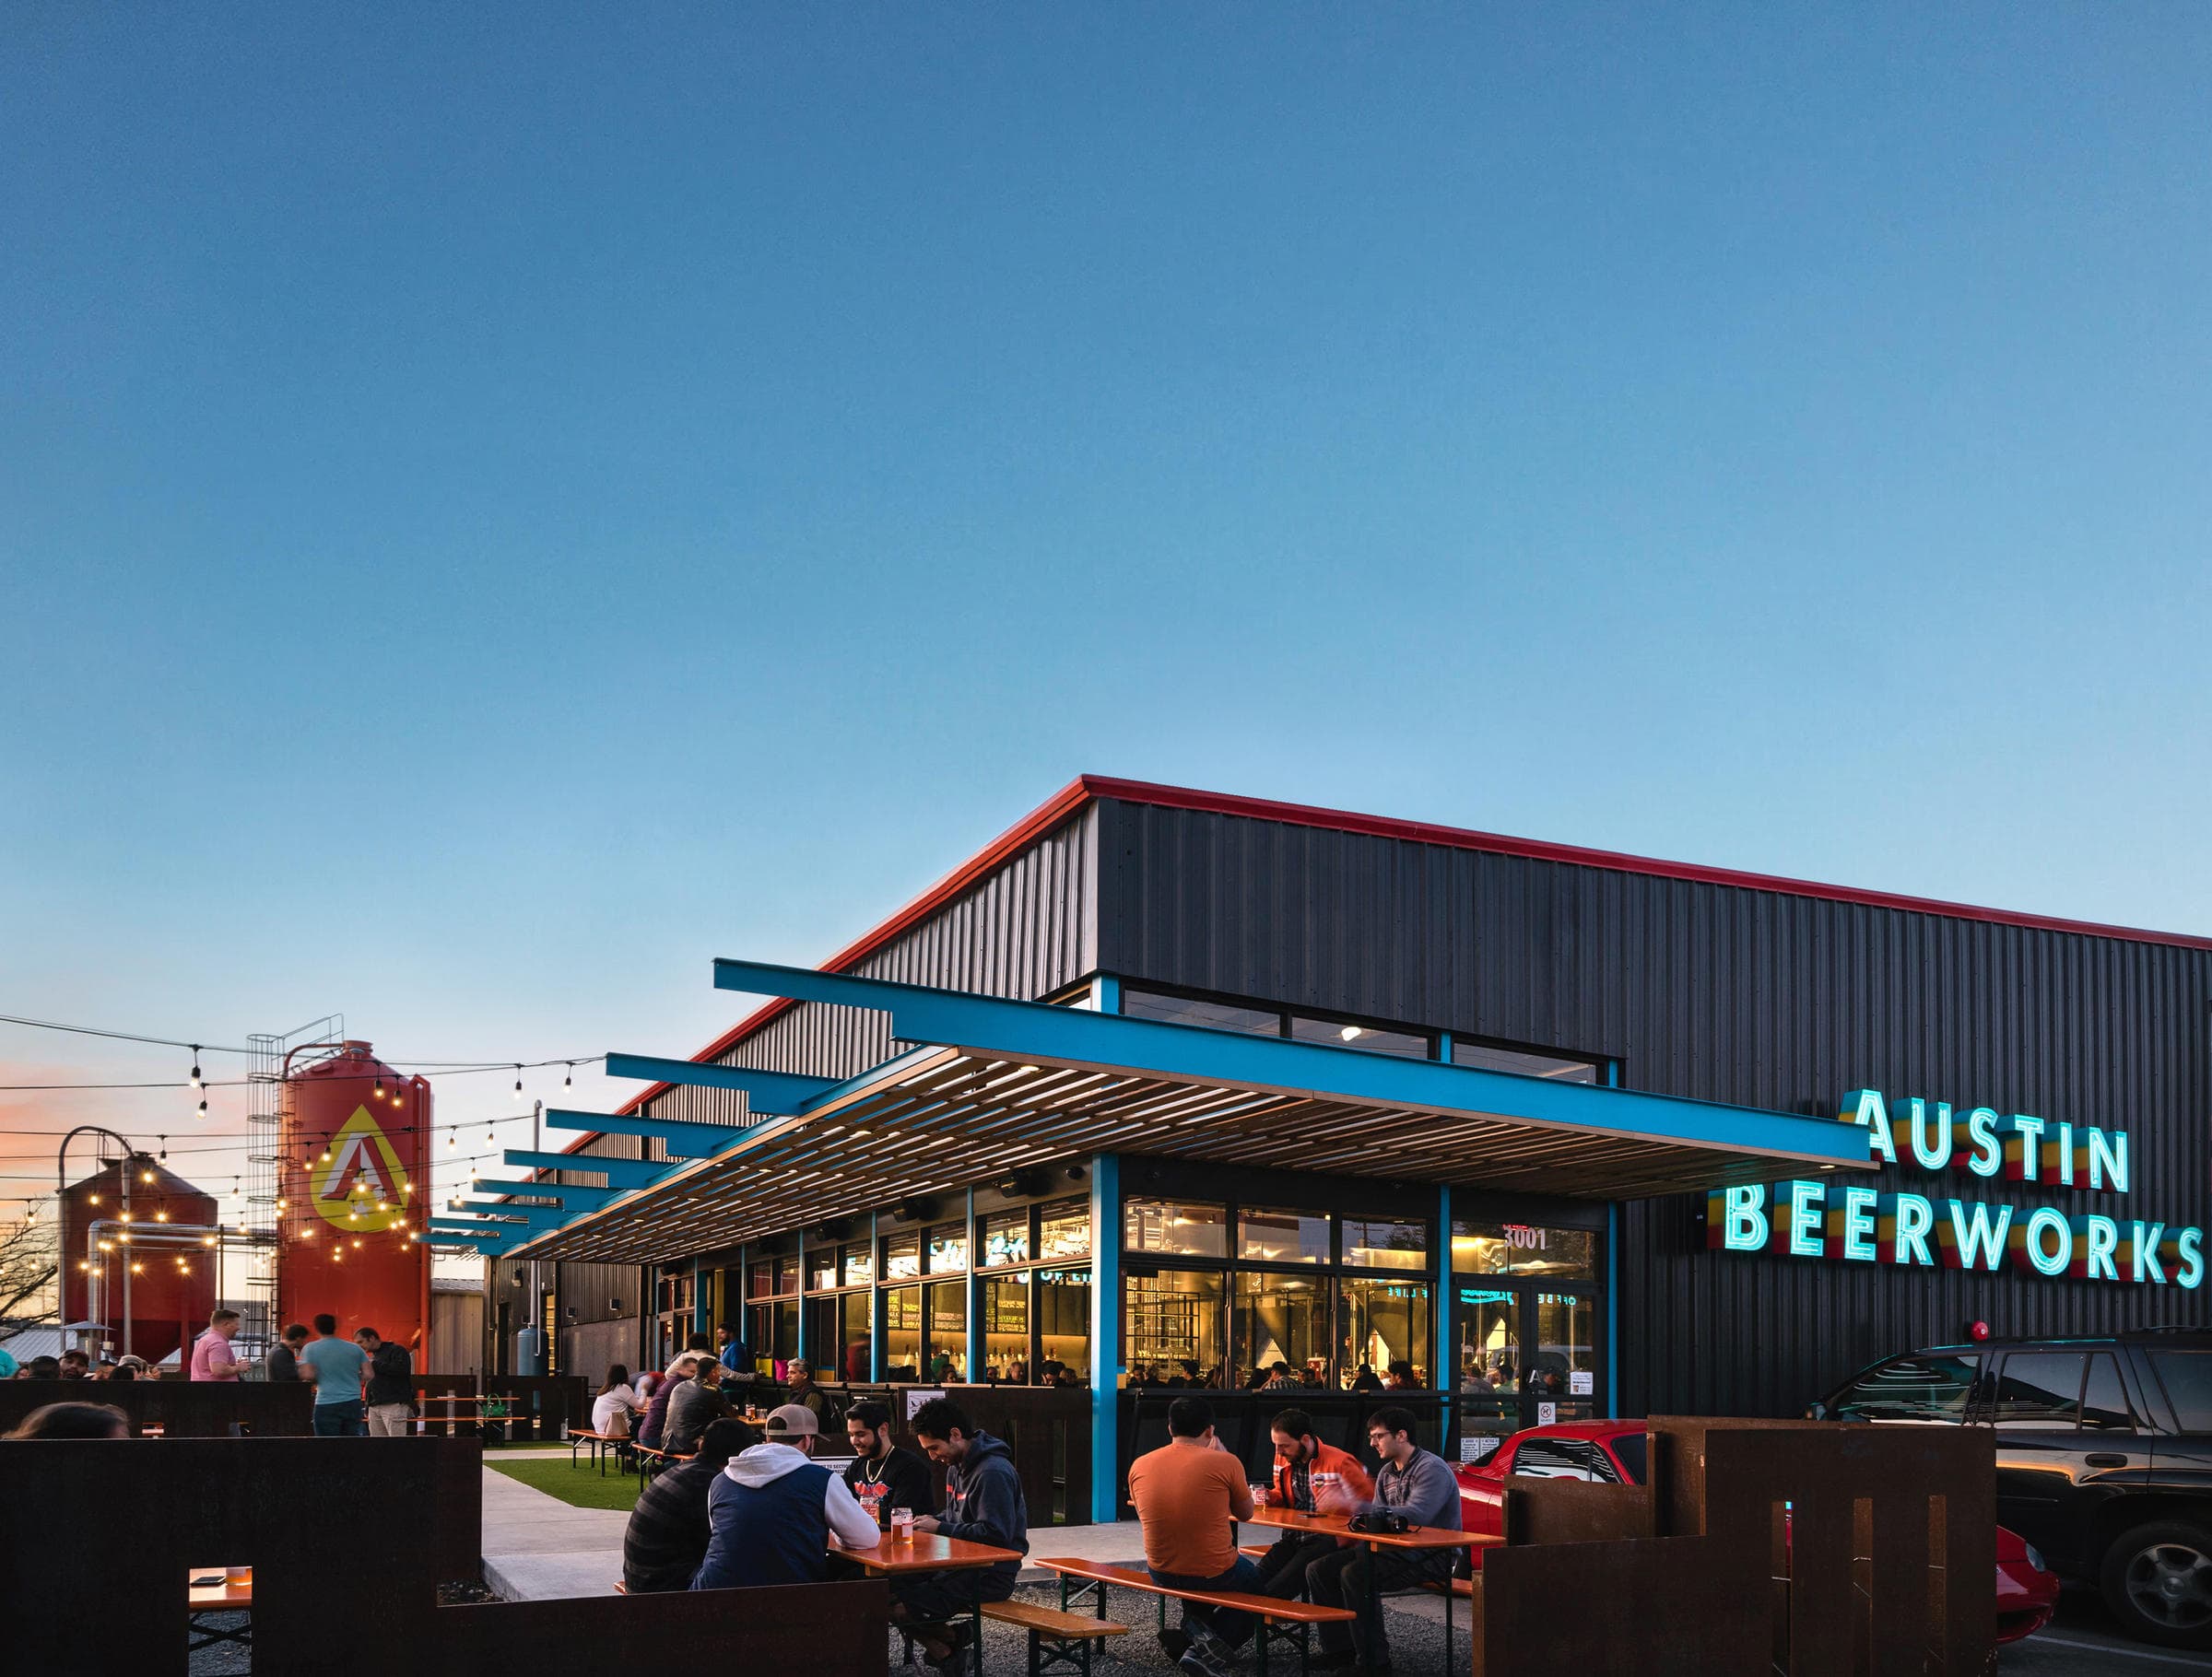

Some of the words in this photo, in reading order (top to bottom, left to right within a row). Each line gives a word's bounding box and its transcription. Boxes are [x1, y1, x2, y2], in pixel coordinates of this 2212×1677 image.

[1854, 1088, 2129, 1193] AUSTIN
[1503, 1226, 1546, 1250] 3001
[1724, 1179, 2205, 1289] BEERWORKS
